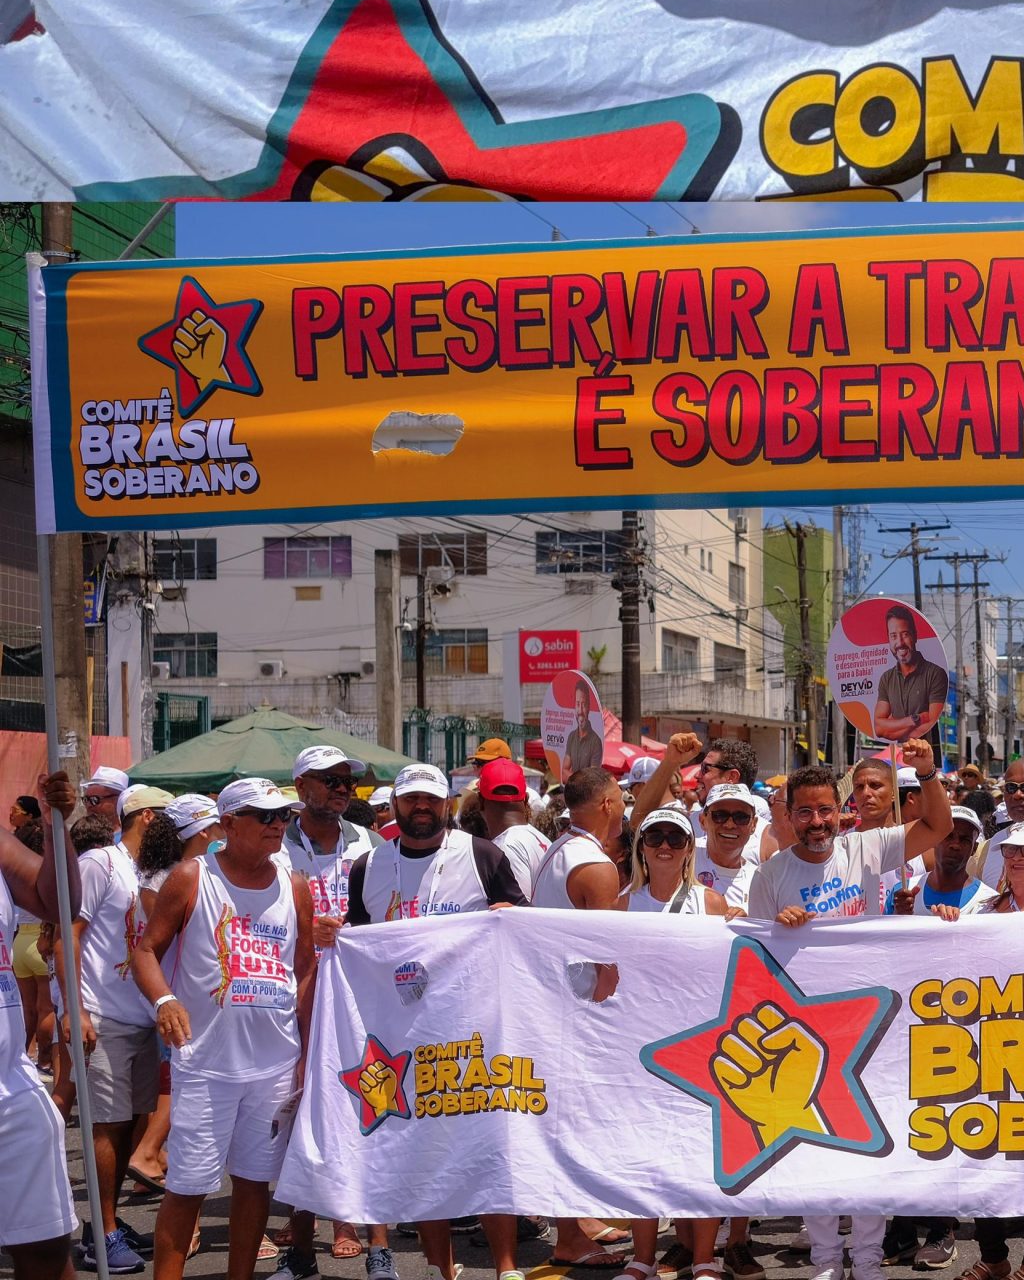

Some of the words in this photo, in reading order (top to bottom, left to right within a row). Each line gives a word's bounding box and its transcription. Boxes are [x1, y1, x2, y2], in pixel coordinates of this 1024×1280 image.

[291, 265, 769, 379] PRESERVAR
[787, 261, 851, 356] A
[81, 387, 174, 424] COMITÊ
[574, 350, 634, 471] É
[79, 418, 253, 467] BRASIL
[84, 461, 260, 501] SOBERANO
[545, 639, 574, 651] sabin
[837, 672, 851, 680] para
[800, 883, 822, 902] Fé
[821, 877, 842, 894] no
[441, 901, 461, 912] NÃO
[231, 914, 251, 936] FÉ
[254, 923, 271, 933] QUE
[272, 925, 288, 937] NÃO
[232, 938, 268, 955] FOGE
[231, 954, 287, 978] LUTA
[232, 985, 249, 994] COM
[253, 986, 257, 994] O
[260, 986, 277, 995] POVO
[414, 1032, 484, 1062] COMITÊ
[414, 1054, 546, 1094] BRASIL
[414, 1088, 548, 1119] SOBERANO
